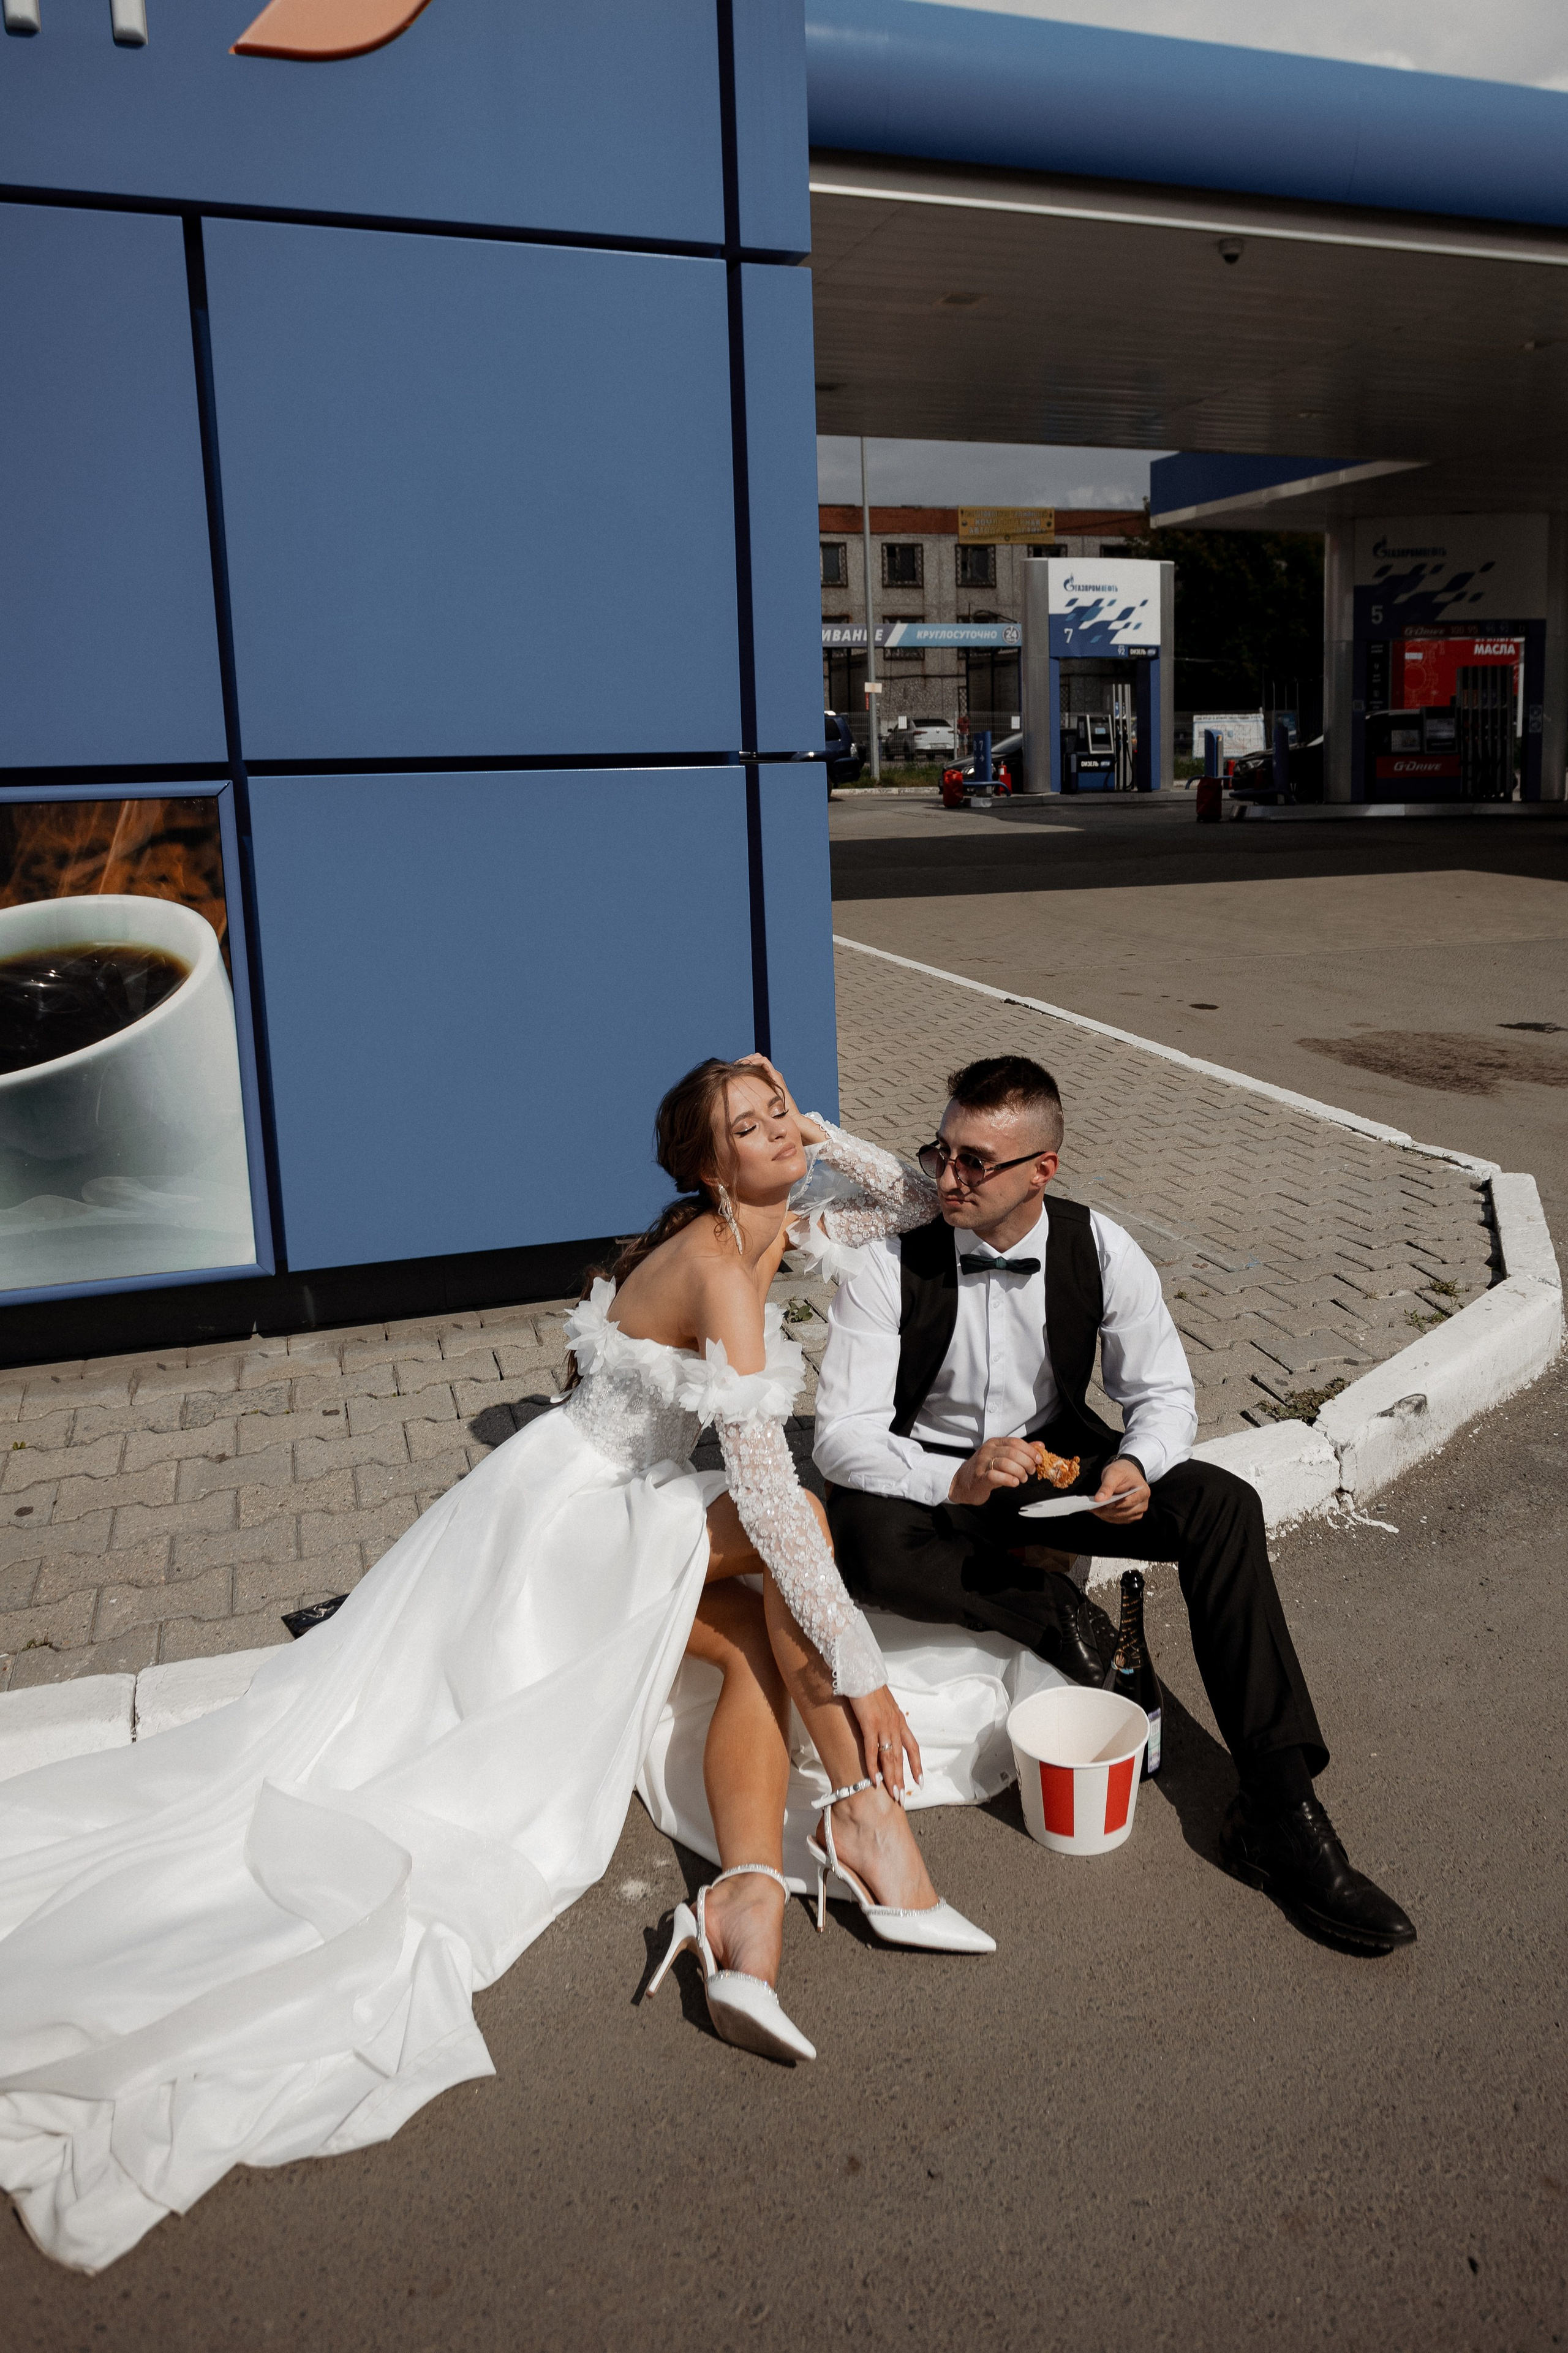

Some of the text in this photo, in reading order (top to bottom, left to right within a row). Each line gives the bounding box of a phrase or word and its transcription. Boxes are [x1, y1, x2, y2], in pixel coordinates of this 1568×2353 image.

[1371, 605, 1384, 624] 5
[917, 630, 998, 640] КРУГЛОСУТОЧНО
[1006, 630, 1017, 638] 24
[1064, 628, 1074, 644] 7
[1474, 644, 1516, 655] МАСЛА
[979, 740, 984, 751] 7
